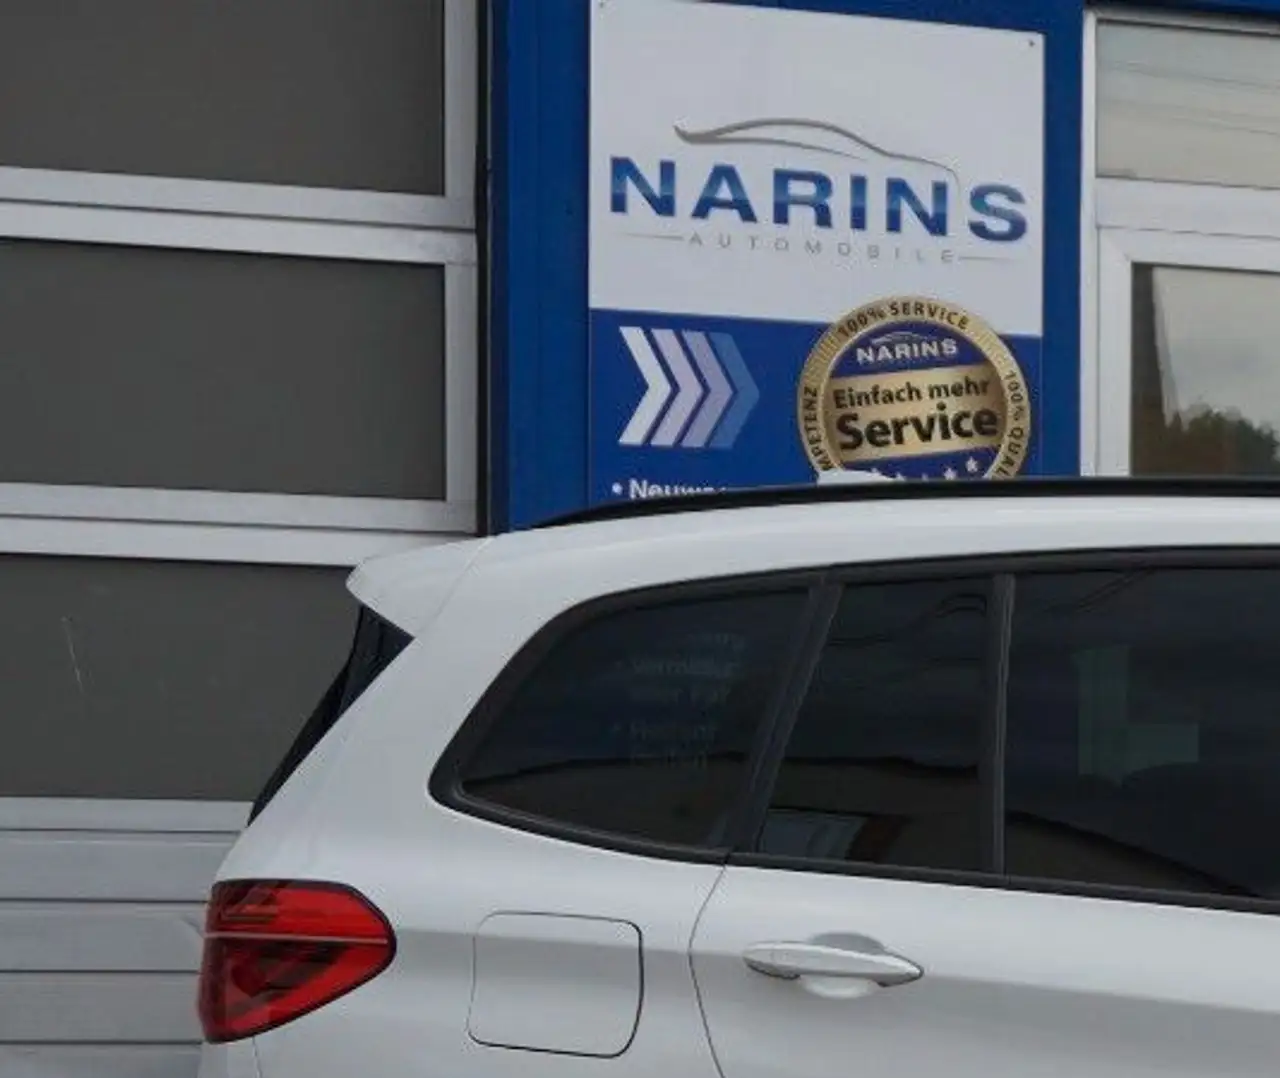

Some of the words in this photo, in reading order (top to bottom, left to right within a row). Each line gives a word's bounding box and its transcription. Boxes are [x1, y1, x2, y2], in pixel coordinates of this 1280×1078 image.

[609, 155, 1028, 243] NARINS
[688, 232, 954, 264] AUTOMOBILE
[837, 306, 886, 337] 100%
[889, 300, 969, 330] SERVICE
[856, 337, 958, 364] NARINS
[832, 381, 924, 409] Einfach
[928, 375, 990, 399] mehr
[1003, 369, 1024, 421] 100%
[803, 386, 834, 471] MPETENZ
[835, 400, 999, 450] Service
[994, 426, 1024, 477] QUAL
